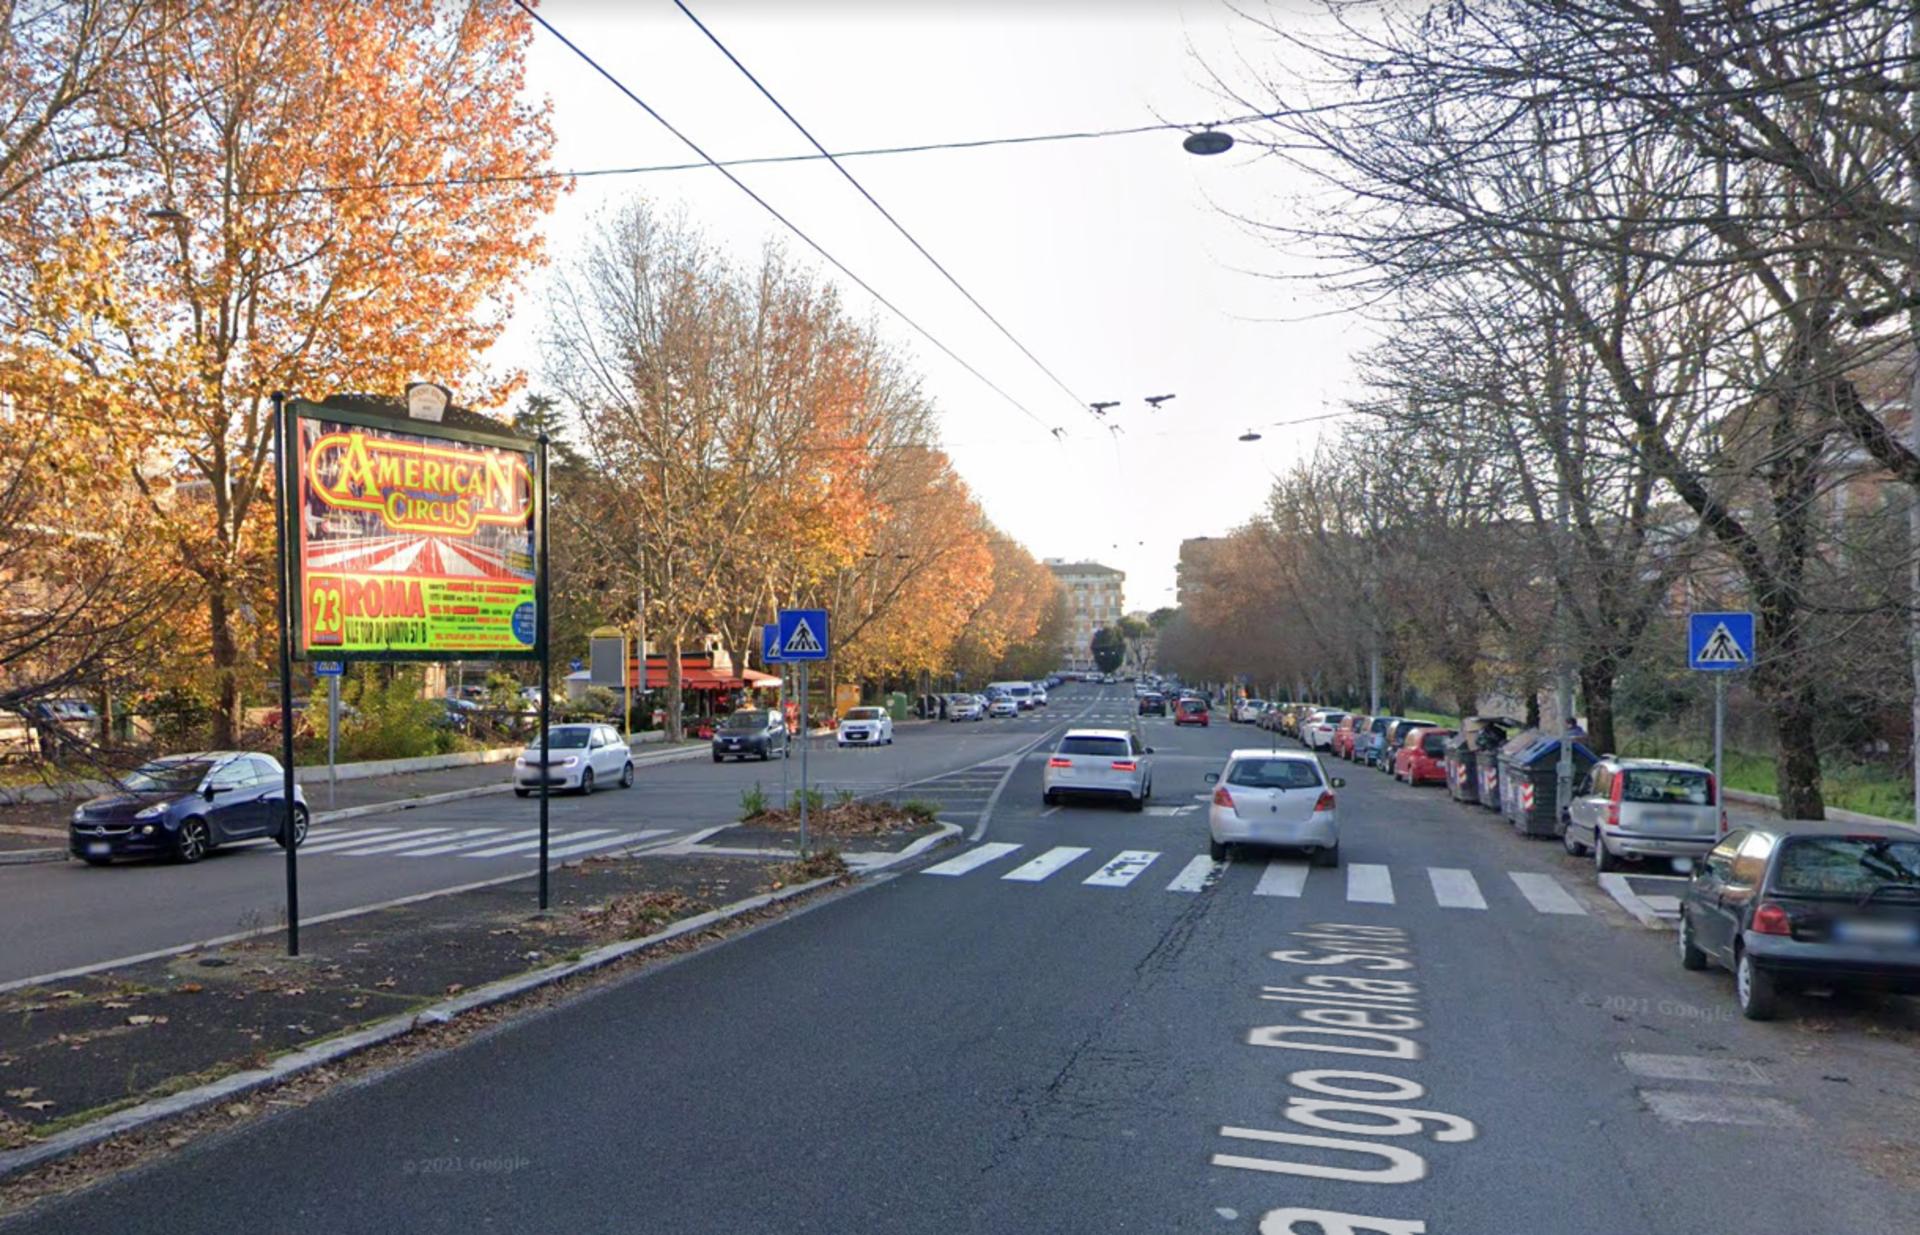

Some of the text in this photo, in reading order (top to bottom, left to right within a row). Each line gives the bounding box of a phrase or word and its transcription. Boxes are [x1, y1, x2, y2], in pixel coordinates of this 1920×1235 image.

[332, 434, 515, 509] AMERICAN
[387, 492, 471, 528] CIRCUS
[313, 588, 340, 632] 23
[345, 579, 426, 617] ROMA
